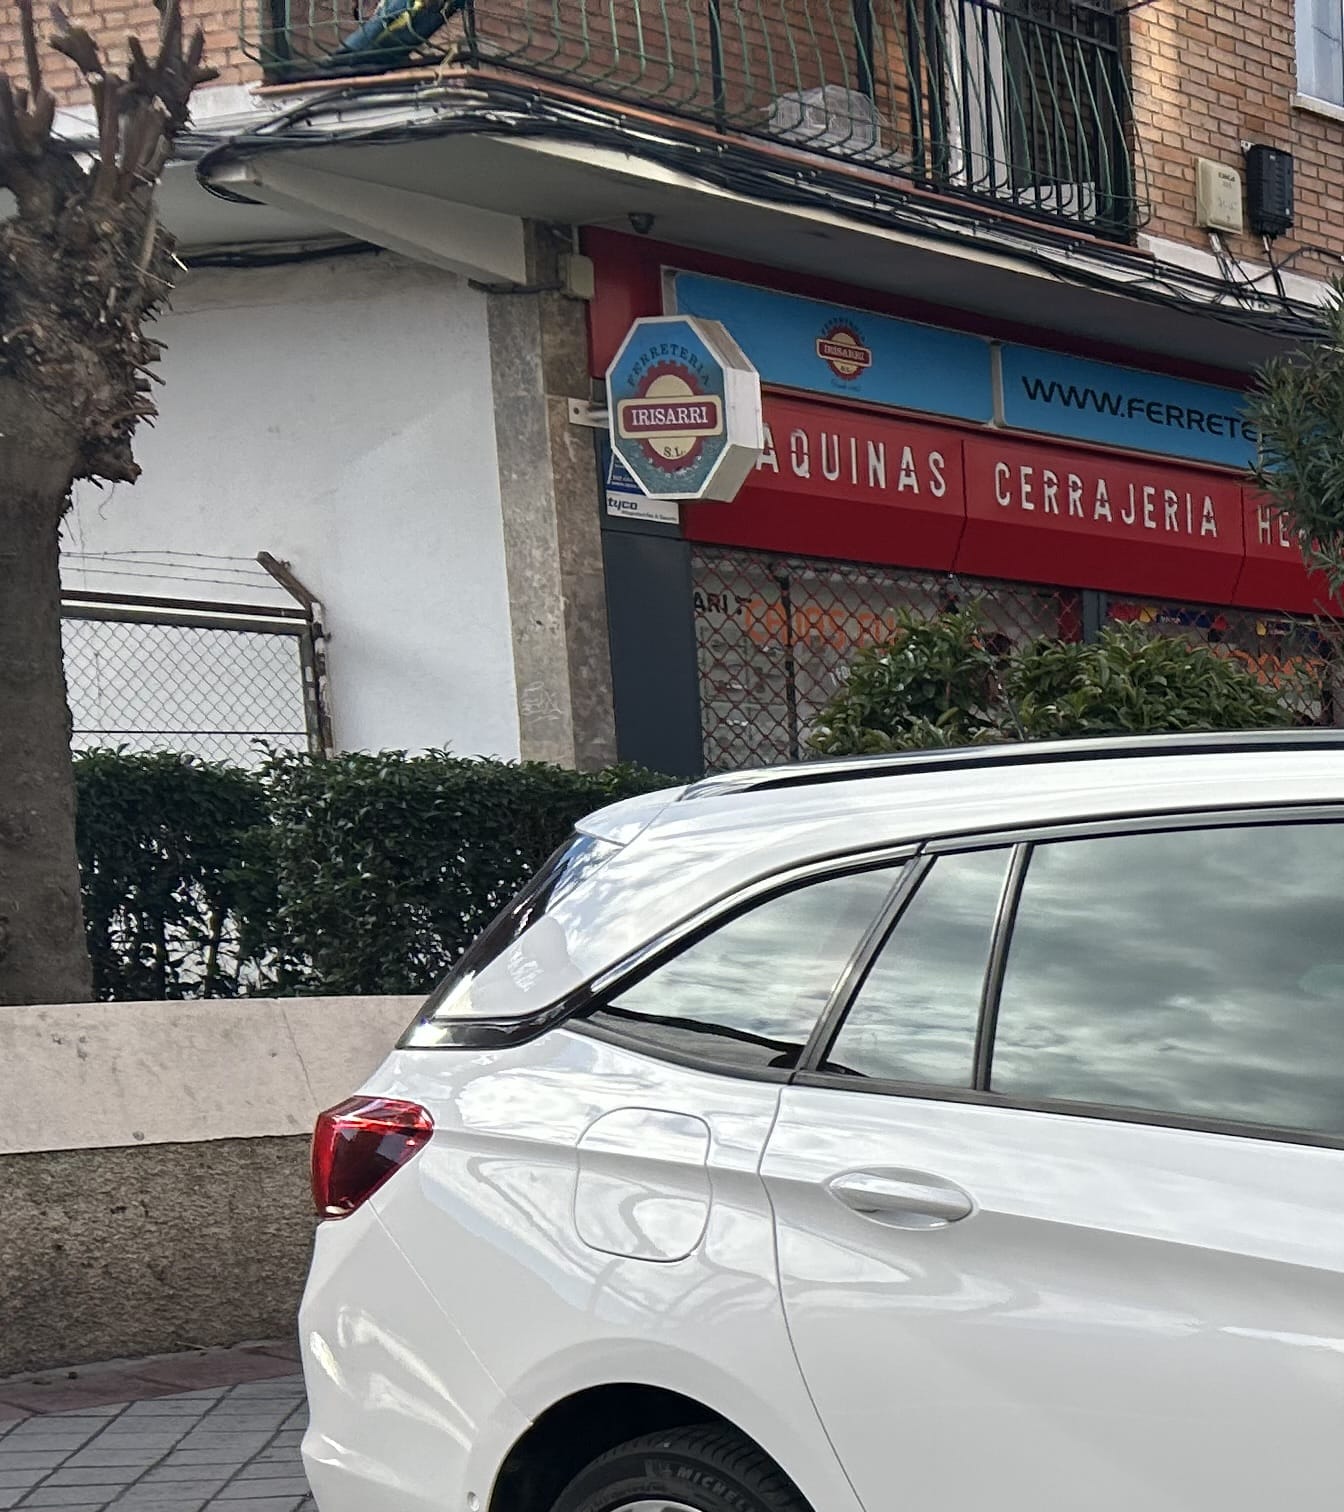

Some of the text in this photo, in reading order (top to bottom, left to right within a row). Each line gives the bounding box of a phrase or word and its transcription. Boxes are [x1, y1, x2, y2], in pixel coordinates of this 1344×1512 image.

[627, 343, 710, 389] FERRETERIA
[631, 406, 709, 426] IRISARRI
[755, 422, 946, 498] AQUINAS
[607, 497, 638, 511] tyco
[994, 461, 1218, 538] CERRAJERIA
